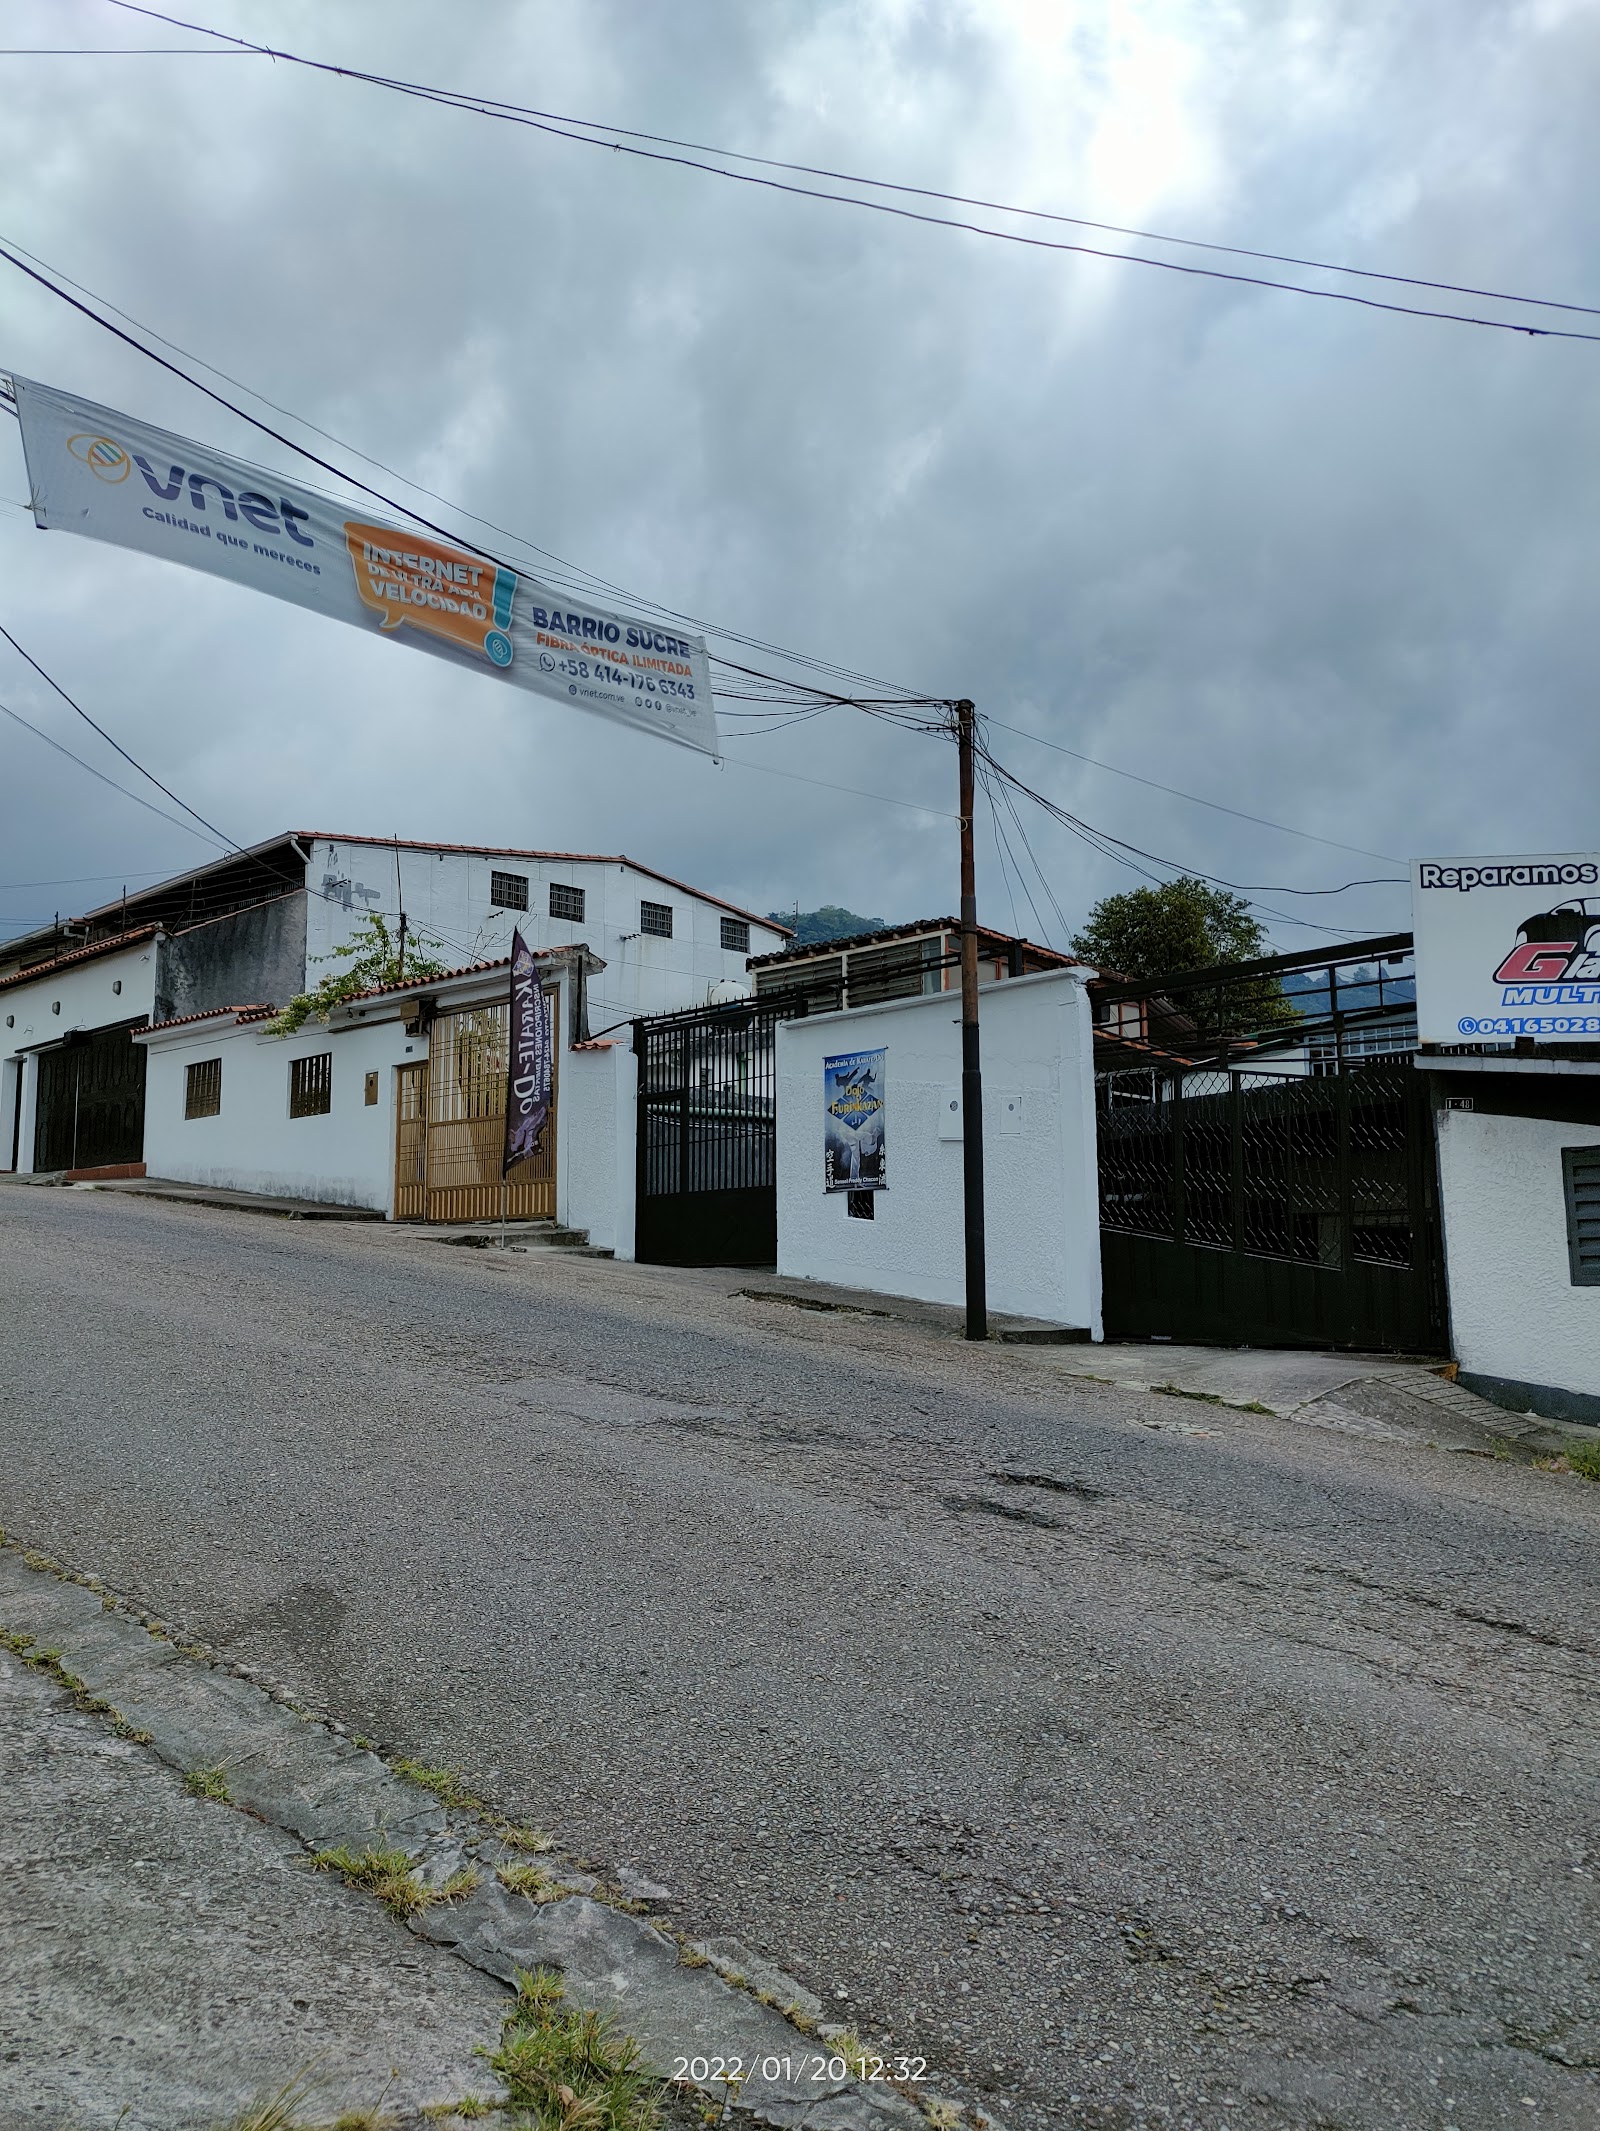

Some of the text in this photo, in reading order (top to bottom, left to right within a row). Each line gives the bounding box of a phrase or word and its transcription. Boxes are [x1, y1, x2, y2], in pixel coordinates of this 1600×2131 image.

[131, 454, 314, 547] vnet
[141, 506, 321, 576] Calidad que mereces
[363, 541, 484, 587] INTERNET
[368, 578, 487, 621] VELOCIDAD
[532, 606, 691, 659] BARRIO SUCRE
[536, 631, 693, 678] FIBRA ÓPTICA ILIMITADA
[558, 658, 695, 700] +58 414-176 6343
[579, 687, 625, 703] vnet.com.ve
[1420, 863, 1598, 892] Reparamos
[1501, 985, 1600, 1006] MULT
[1476, 1016, 1600, 1036] 04165028
